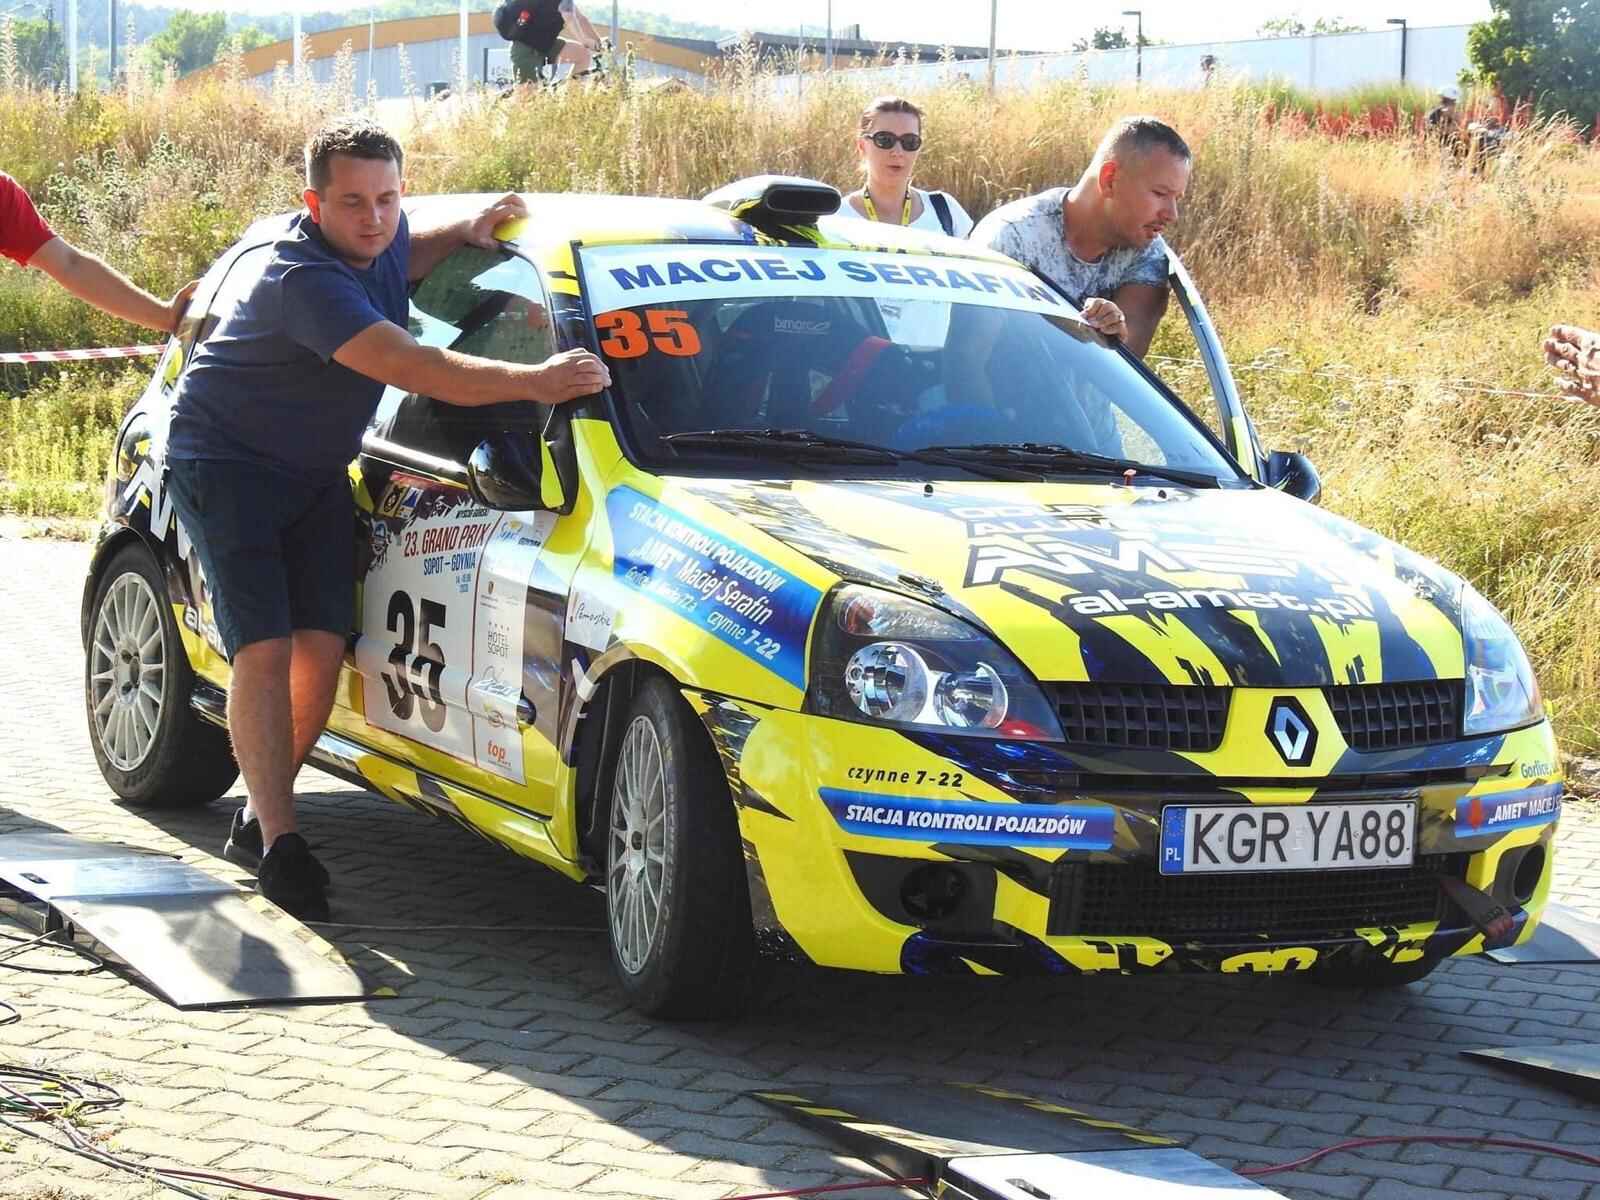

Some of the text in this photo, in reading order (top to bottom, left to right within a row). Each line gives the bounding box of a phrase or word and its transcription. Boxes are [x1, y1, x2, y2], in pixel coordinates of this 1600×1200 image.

[608, 259, 1060, 306] MACIEJ SERAFIN
[595, 309, 702, 360] 35
[404, 531, 420, 557] 23.
[422, 526, 456, 554] GRAND
[459, 523, 492, 549] PRIX
[424, 556, 444, 575] SOPOT
[451, 551, 476, 571] GDYNIA
[711, 544, 788, 593] POJAZDÓW
[676, 555, 727, 601] Maciej
[716, 580, 773, 626] Serafin
[1071, 588, 1376, 620] al-amet.pl
[706, 610, 781, 660] czynne 7-22
[381, 590, 448, 733] 35
[488, 739, 506, 761] top
[848, 766, 964, 788] czynne 7-22
[846, 804, 1087, 835] STACJA KONTROLI POJAZDÓW
[1191, 809, 1407, 865] KGR YA88
[1165, 847, 1182, 862] PL
